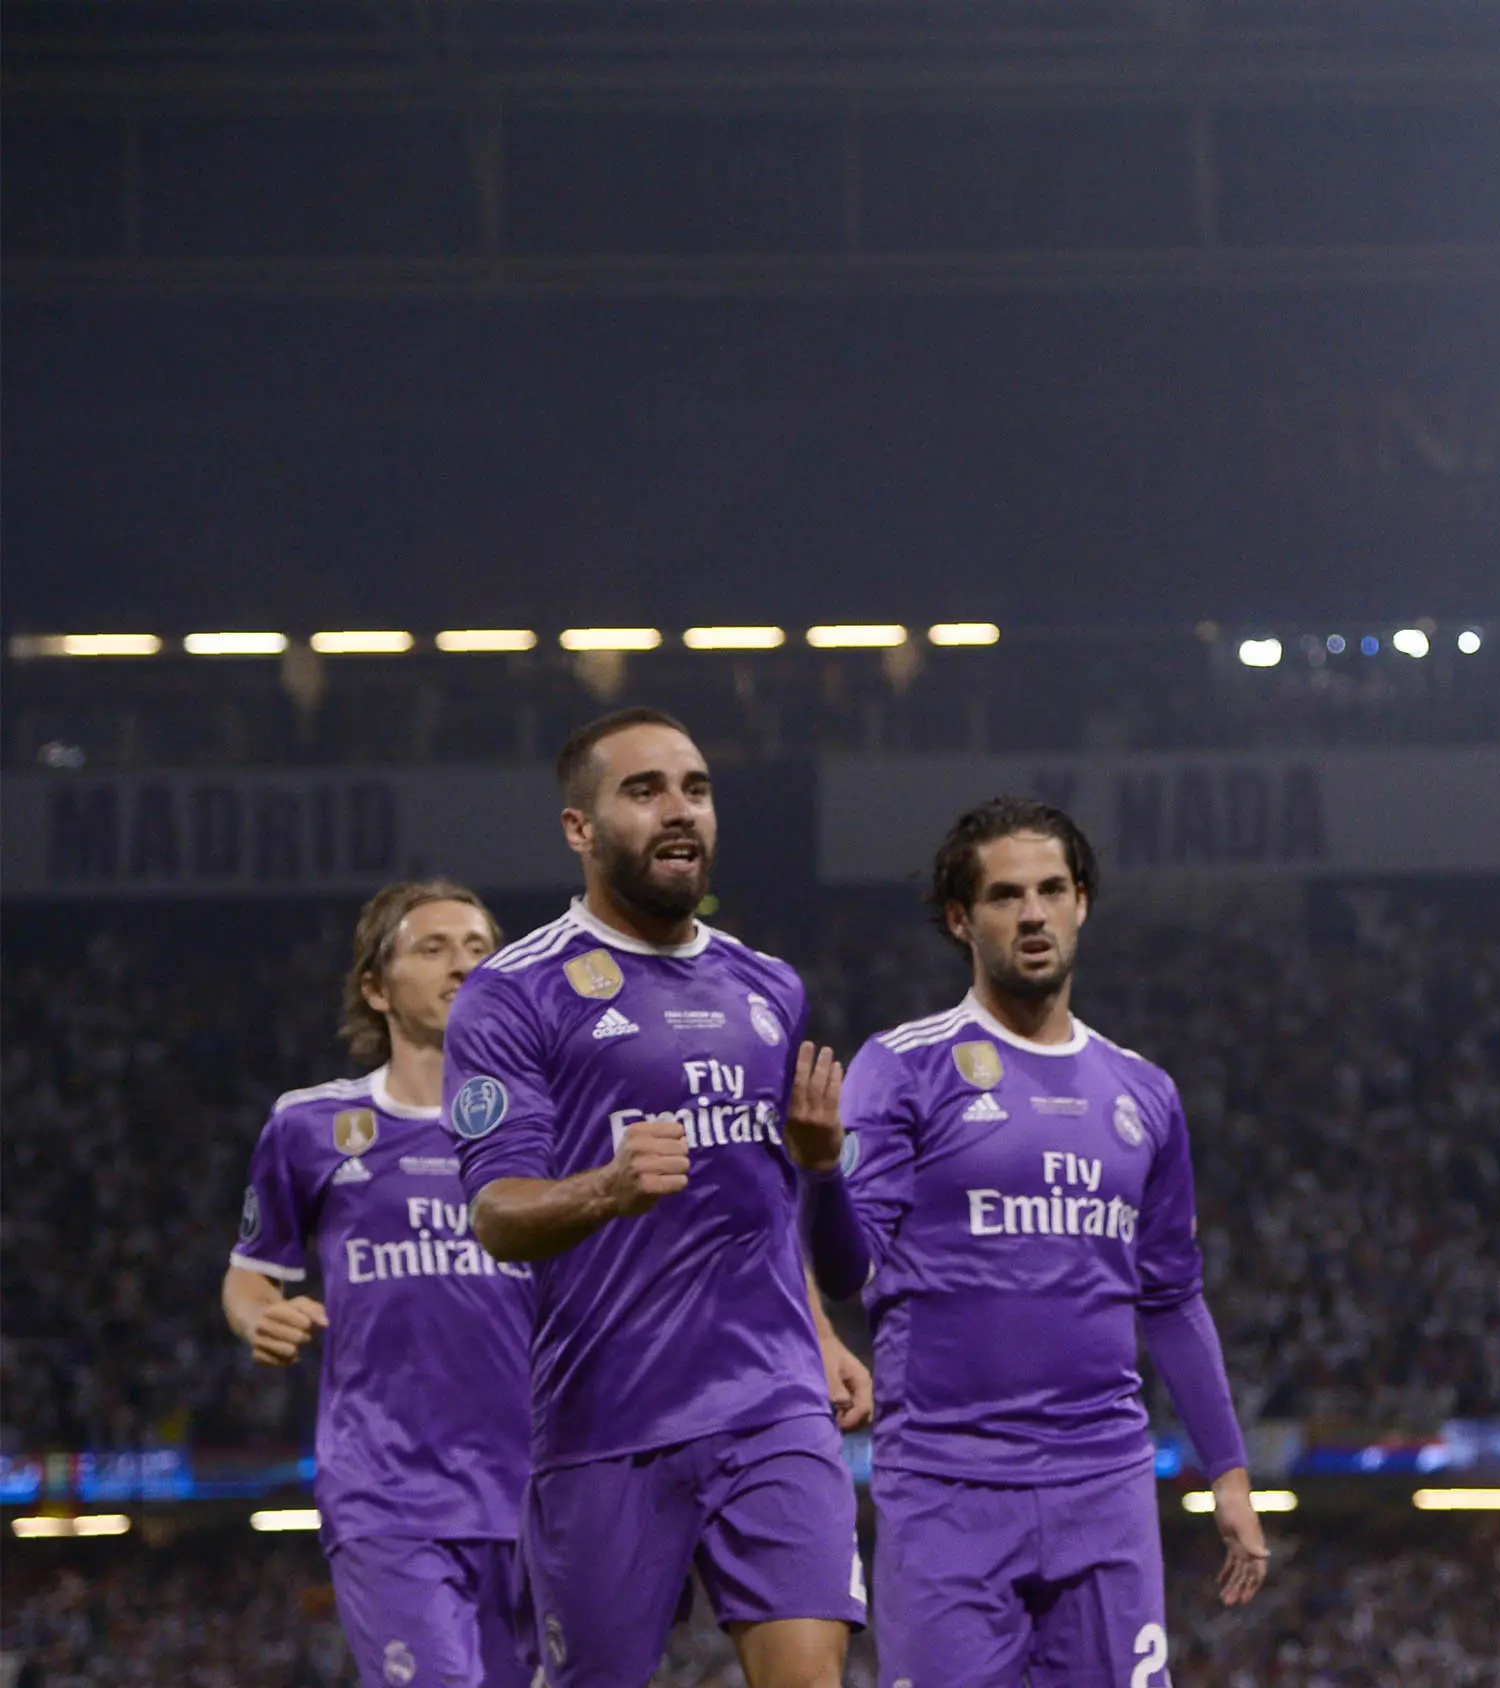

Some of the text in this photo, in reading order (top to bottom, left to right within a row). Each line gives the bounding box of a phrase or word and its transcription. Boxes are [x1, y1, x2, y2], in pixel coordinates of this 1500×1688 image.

[1117, 763, 1328, 867] NADA
[683, 1058, 745, 1099] Fly
[1042, 1151, 1102, 1192] Fly
[406, 1196, 468, 1236] Fly
[1130, 1623, 1173, 1688] 2
